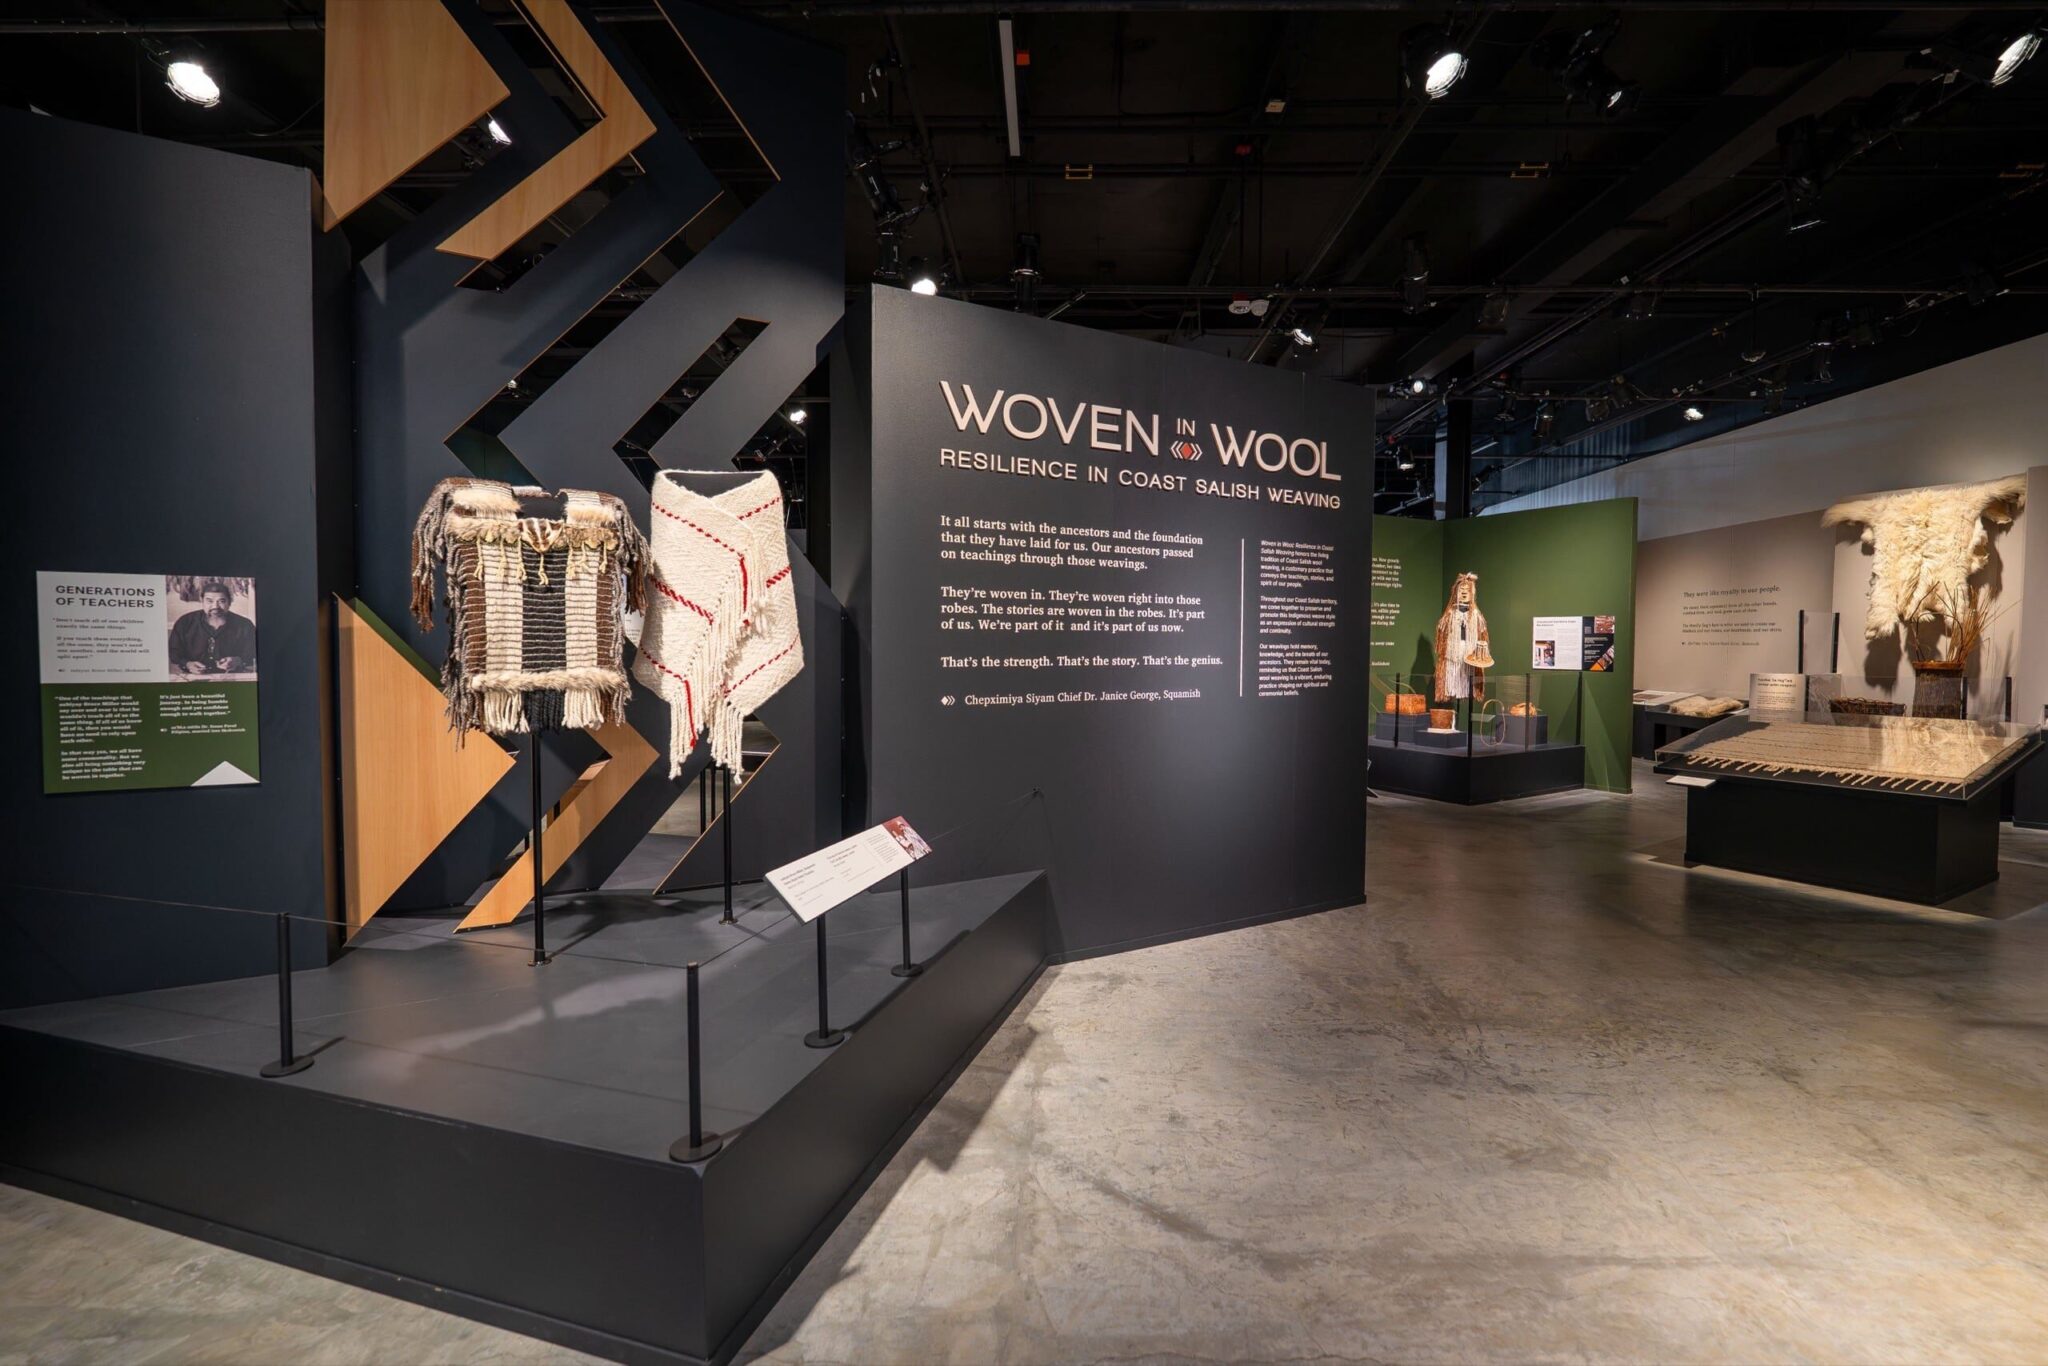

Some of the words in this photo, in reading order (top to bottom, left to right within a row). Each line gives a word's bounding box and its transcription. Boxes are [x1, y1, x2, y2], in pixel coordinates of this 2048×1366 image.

[939, 380, 1159, 456] WOVEN
[1176, 418, 1195, 437] IN
[1210, 423, 1342, 481] WOOL
[940, 448, 1077, 480] RESILIENCE
[1088, 465, 1108, 483] IN
[1118, 469, 1187, 492] COAST
[1195, 478, 1260, 500] SALISH
[1267, 487, 1340, 509] WEAVING
[940, 515, 951, 526] It
[954, 516, 970, 528] all
[973, 519, 1006, 530] starts
[1009, 520, 1036, 533] with
[1039, 522, 1057, 534] the
[1059, 526, 1110, 538] ancestors
[1112, 529, 1131, 539] and
[1134, 530, 1150, 541] the
[1152, 531, 1203, 545] foundation
[941, 531, 966, 544] that
[969, 533, 996, 548] they
[999, 534, 1026, 548] have
[1029, 536, 1051, 549] laid
[1054, 538, 1071, 550] for
[1073, 542, 1088, 551] us.
[1091, 541, 1112, 552] Our
[1114, 545, 1160, 556] ancestors
[1162, 548, 1194, 558] passed
[940, 550, 956, 559] on
[960, 550, 1016, 565] teachings
[1019, 552, 1064, 567] through
[1067, 554, 1096, 567] those
[1098, 557, 1148, 571] weavings.
[55, 585, 155, 597] GENERATIONS
[940, 586, 986, 601] They’re
[989, 590, 1027, 599] woven
[1030, 588, 1045, 600] in.
[1048, 589, 1089, 604] They’re
[1092, 593, 1125, 603] woven
[1128, 592, 1152, 605] right
[1154, 593, 1174, 604] into
[1176, 594, 1201, 605] those
[55, 597, 74, 606] OF
[79, 597, 154, 608] TEACHERS
[941, 602, 978, 614] robes.
[981, 603, 1004, 614] The
[1006, 604, 1044, 616] stories
[1047, 607, 1065, 616] are
[1067, 608, 1102, 616] woven
[1105, 606, 1116, 617] in
[1118, 606, 1135, 617] the
[1136, 607, 1166, 618] robes.
[1168, 608, 1184, 619] It’s
[1185, 610, 1205, 621] part
[940, 619, 953, 629] of
[957, 621, 974, 630] us.
[978, 619, 1012, 630] We’re
[1014, 621, 1038, 633] part
[1041, 620, 1052, 630] of
[1055, 620, 1064, 630] it
[1070, 620, 1090, 631] and
[1093, 620, 1109, 631] it’s
[1112, 622, 1133, 634] part
[1135, 621, 1146, 632] of
[1147, 624, 1159, 632] us
[1161, 624, 1184, 632] now.
[940, 656, 978, 668] That’s
[981, 656, 1000, 667] the
[1003, 655, 1054, 669] strength.
[1056, 655, 1090, 666] That’s
[1092, 655, 1109, 666] the
[1111, 656, 1140, 668] story.
[1142, 655, 1172, 665] That’s
[1174, 655, 1189, 665] the
[1191, 655, 1223, 668] genius.
[964, 693, 1023, 707] Chepximiya
[1025, 693, 1055, 705] Siyam
[1057, 691, 1082, 702] Chief
[1083, 691, 1097, 701] Dr.
[1100, 691, 1128, 701] Janice
[1129, 690, 1162, 702] George,
[1162, 688, 1201, 701] Squamish
